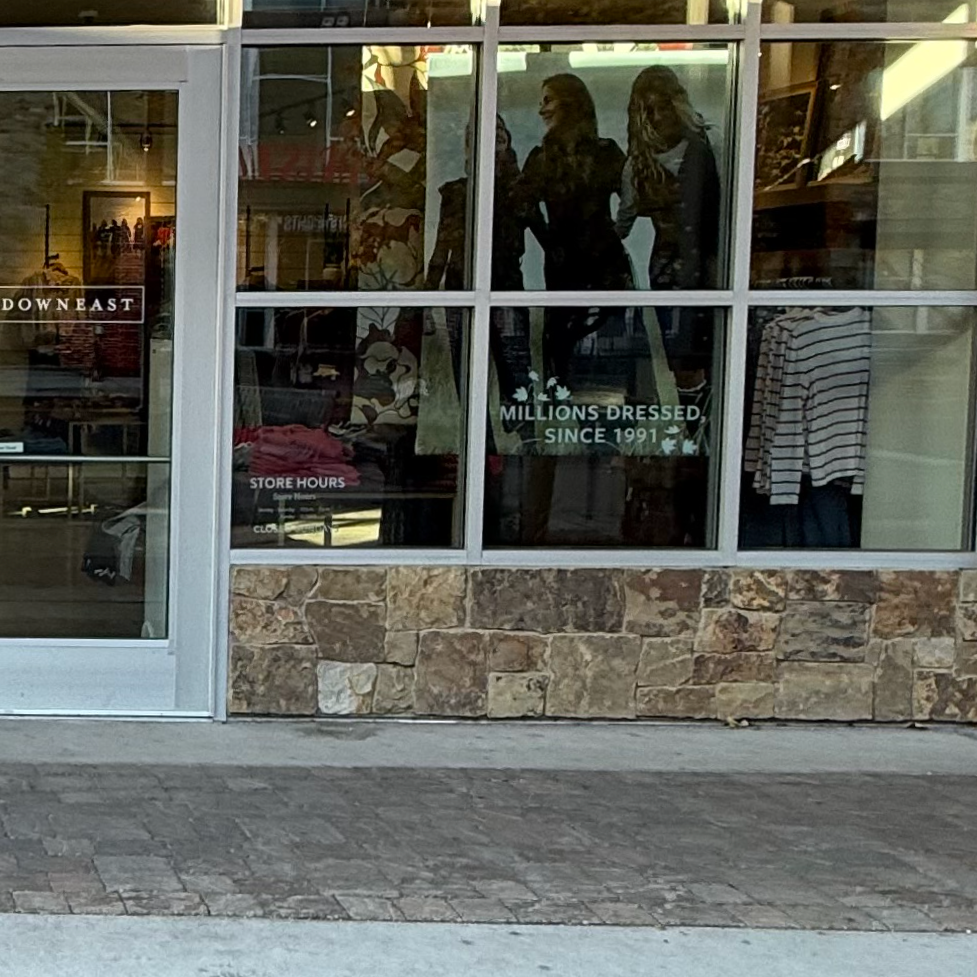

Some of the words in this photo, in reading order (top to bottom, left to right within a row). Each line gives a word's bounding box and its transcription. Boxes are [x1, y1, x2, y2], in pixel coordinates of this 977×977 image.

[1, 297, 135, 312] DOWNEAST
[499, 405, 599, 421] MILLIONS
[544, 427, 607, 444] SINCE
[613, 427, 657, 443] 1991
[249, 476, 294, 489] STORE
[296, 476, 346, 489] HOURS
